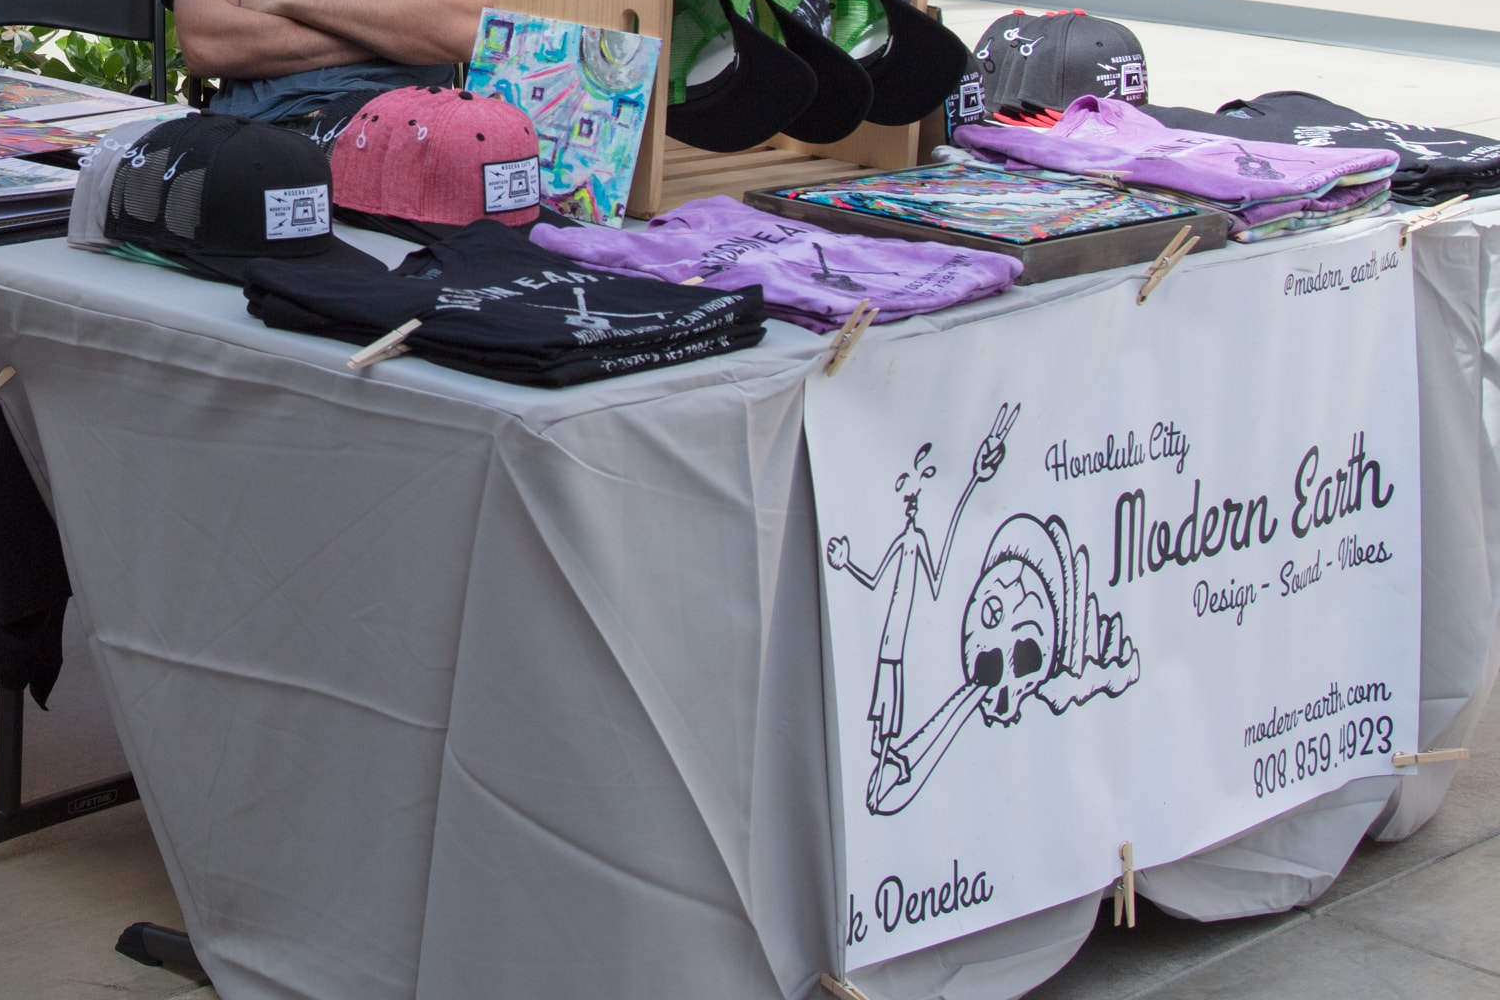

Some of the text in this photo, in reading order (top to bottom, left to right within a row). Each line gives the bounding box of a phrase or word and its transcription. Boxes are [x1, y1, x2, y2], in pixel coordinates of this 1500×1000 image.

[1045, 421, 1190, 482] Honolulu City
[1108, 431, 1394, 587] Modern Earth
[1193, 578, 1257, 626] Design
[1280, 549, 1322, 597] Sound
[1338, 534, 1393, 571] Vibes
[1244, 681, 1392, 748] modern-earth.com
[1253, 715, 1394, 798] 808.859.4923
[875, 859, 994, 933] Deneka
